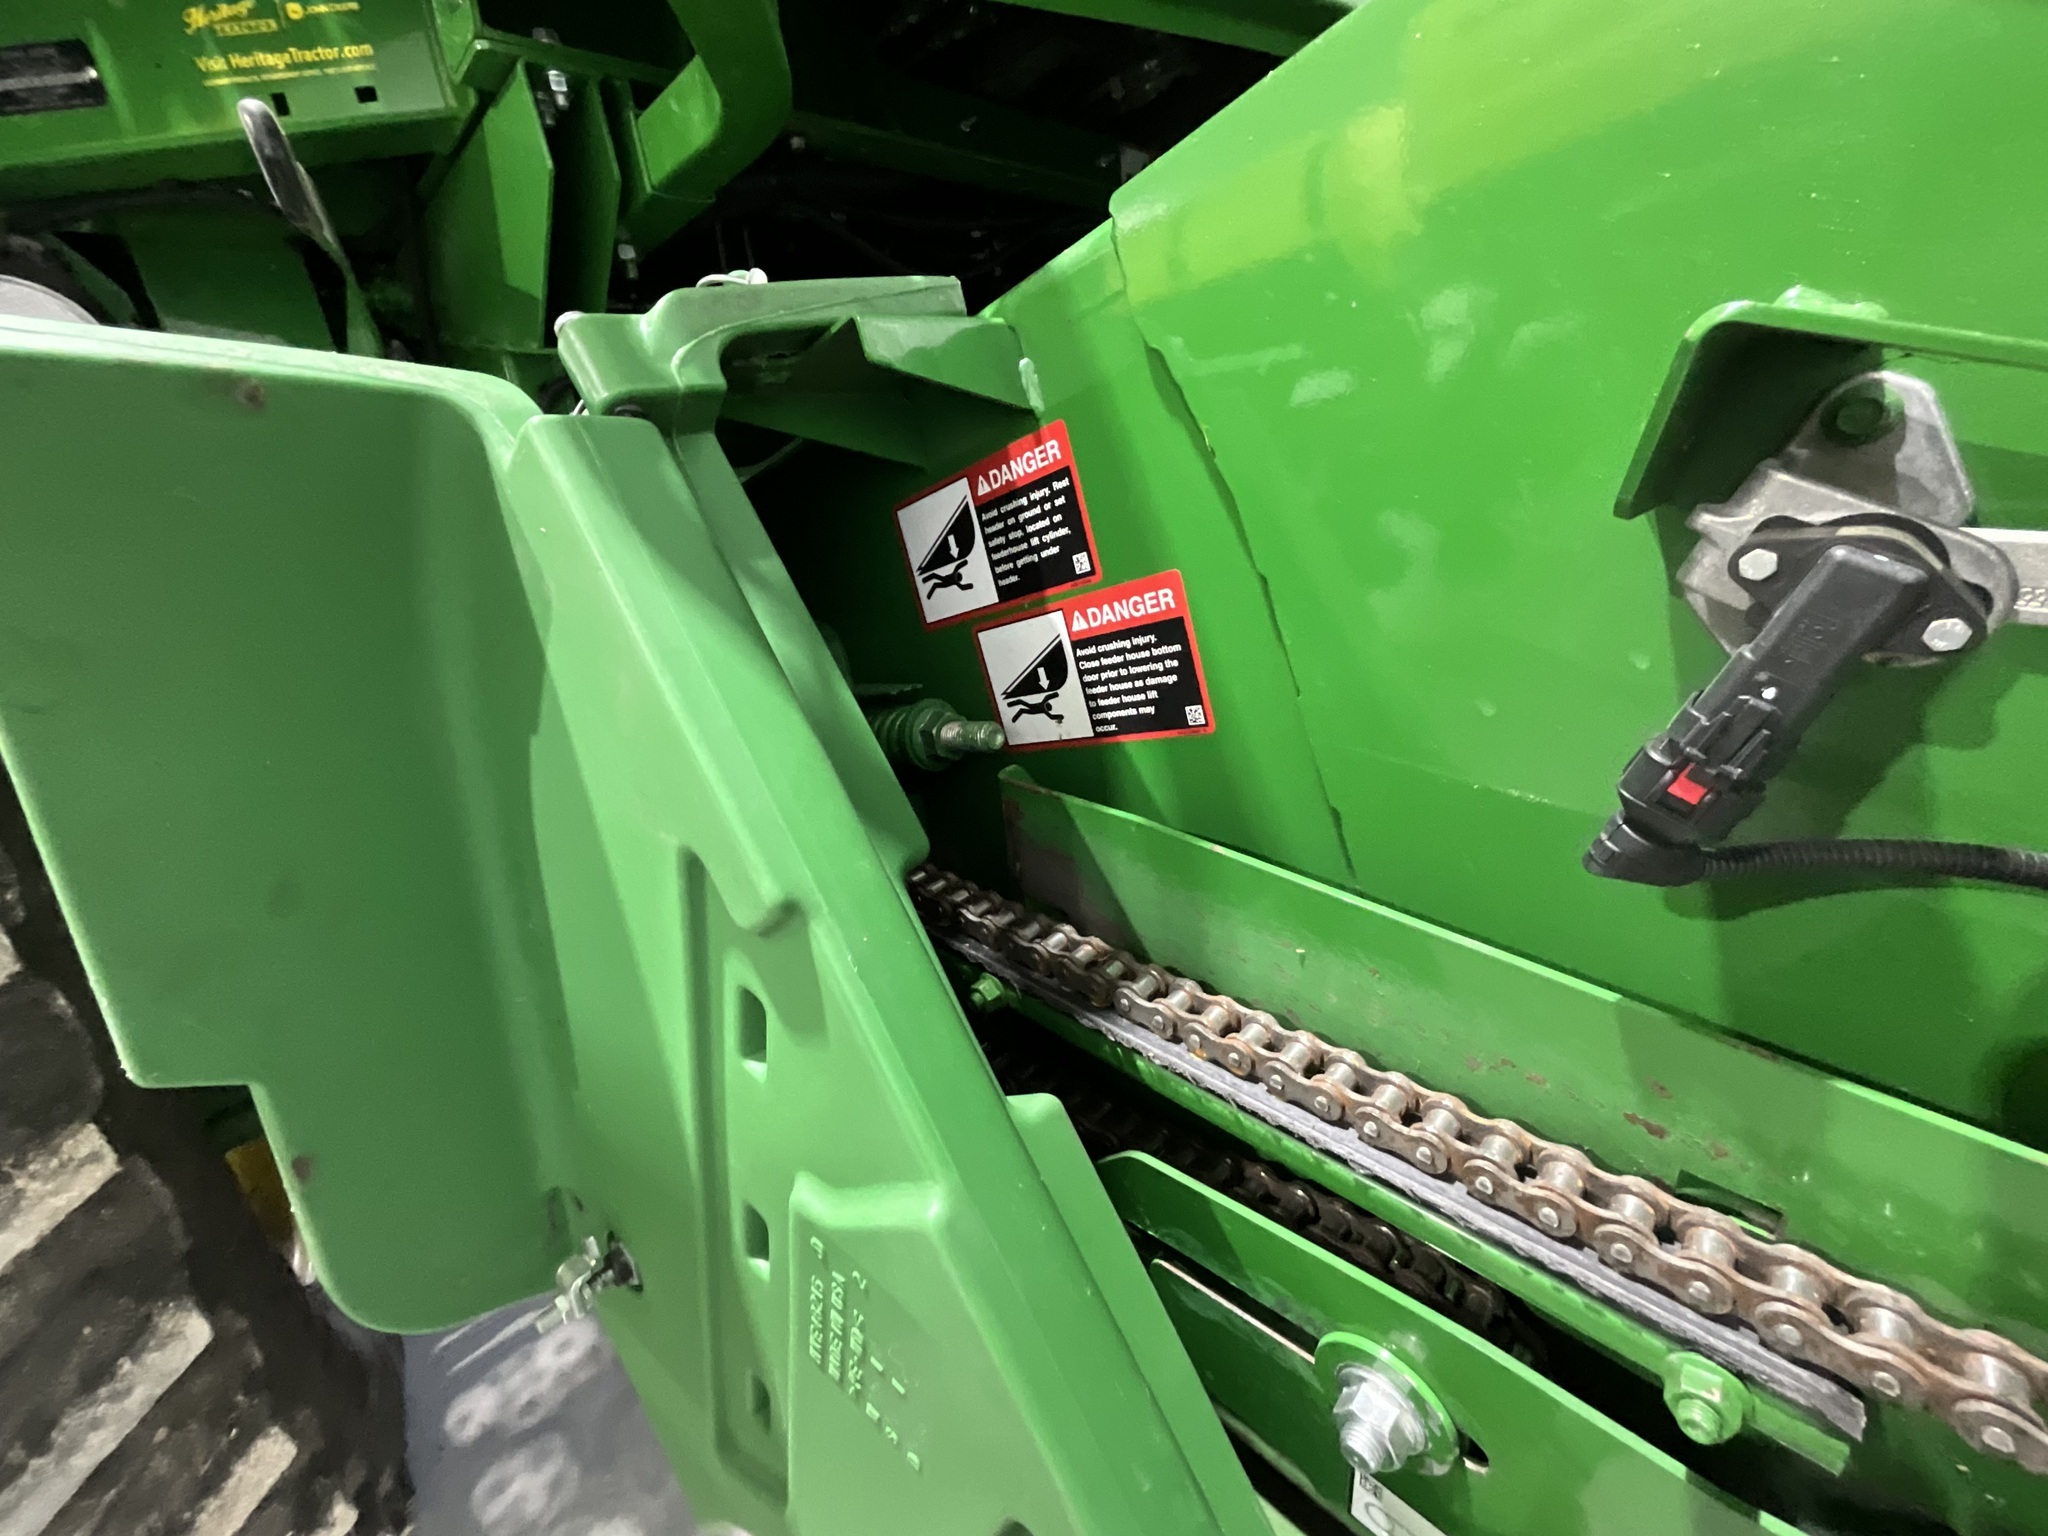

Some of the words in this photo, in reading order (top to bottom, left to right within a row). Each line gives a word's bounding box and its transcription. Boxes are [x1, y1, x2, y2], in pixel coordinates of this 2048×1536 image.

[194, 56, 228, 72] Visit
[228, 44, 374, 69] HeritageTractor.com
[988, 439, 1061, 490] DANGER
[982, 508, 998, 521] Avoid
[1000, 497, 1028, 513] crushing
[1052, 477, 1070, 490] Rest
[984, 521, 1004, 534] header
[1007, 516, 1016, 525] on
[1018, 505, 1041, 523] ground
[1043, 502, 1052, 511] or
[1054, 495, 1066, 507] set
[1025, 517, 1050, 533] located
[1052, 514, 1063, 523] on
[1030, 536, 1040, 547] lift
[994, 562, 1014, 574] before
[1016, 554, 1039, 568] getting
[1040, 545, 1060, 558] under
[1086, 588, 1176, 628] DANGER
[1076, 645, 1097, 657] Avoid
[1097, 638, 1131, 653] crushing
[1131, 634, 1157, 646] injury.
[1079, 660, 1100, 670] Close
[1100, 655, 1124, 667] feeder
[1125, 650, 1150, 661] house
[1151, 643, 1182, 656] bottom
[1082, 673, 1099, 682] door
[1100, 670, 1119, 682] prior
[1119, 667, 1128, 676] to
[1129, 661, 1164, 674] lowering
[1164, 659, 1179, 669] the
[1085, 684, 1108, 695] feeder
[1109, 680, 1133, 692] house
[1134, 679, 1144, 687] as
[1145, 674, 1178, 685] damage
[1089, 700, 1097, 708] to
[1097, 696, 1120, 707] feeder
[1121, 691, 1146, 703] house
[1146, 690, 1159, 700] lift
[1092, 708, 1138, 720] components
[1138, 705, 1155, 716] may
[1095, 723, 1118, 732] occur.
